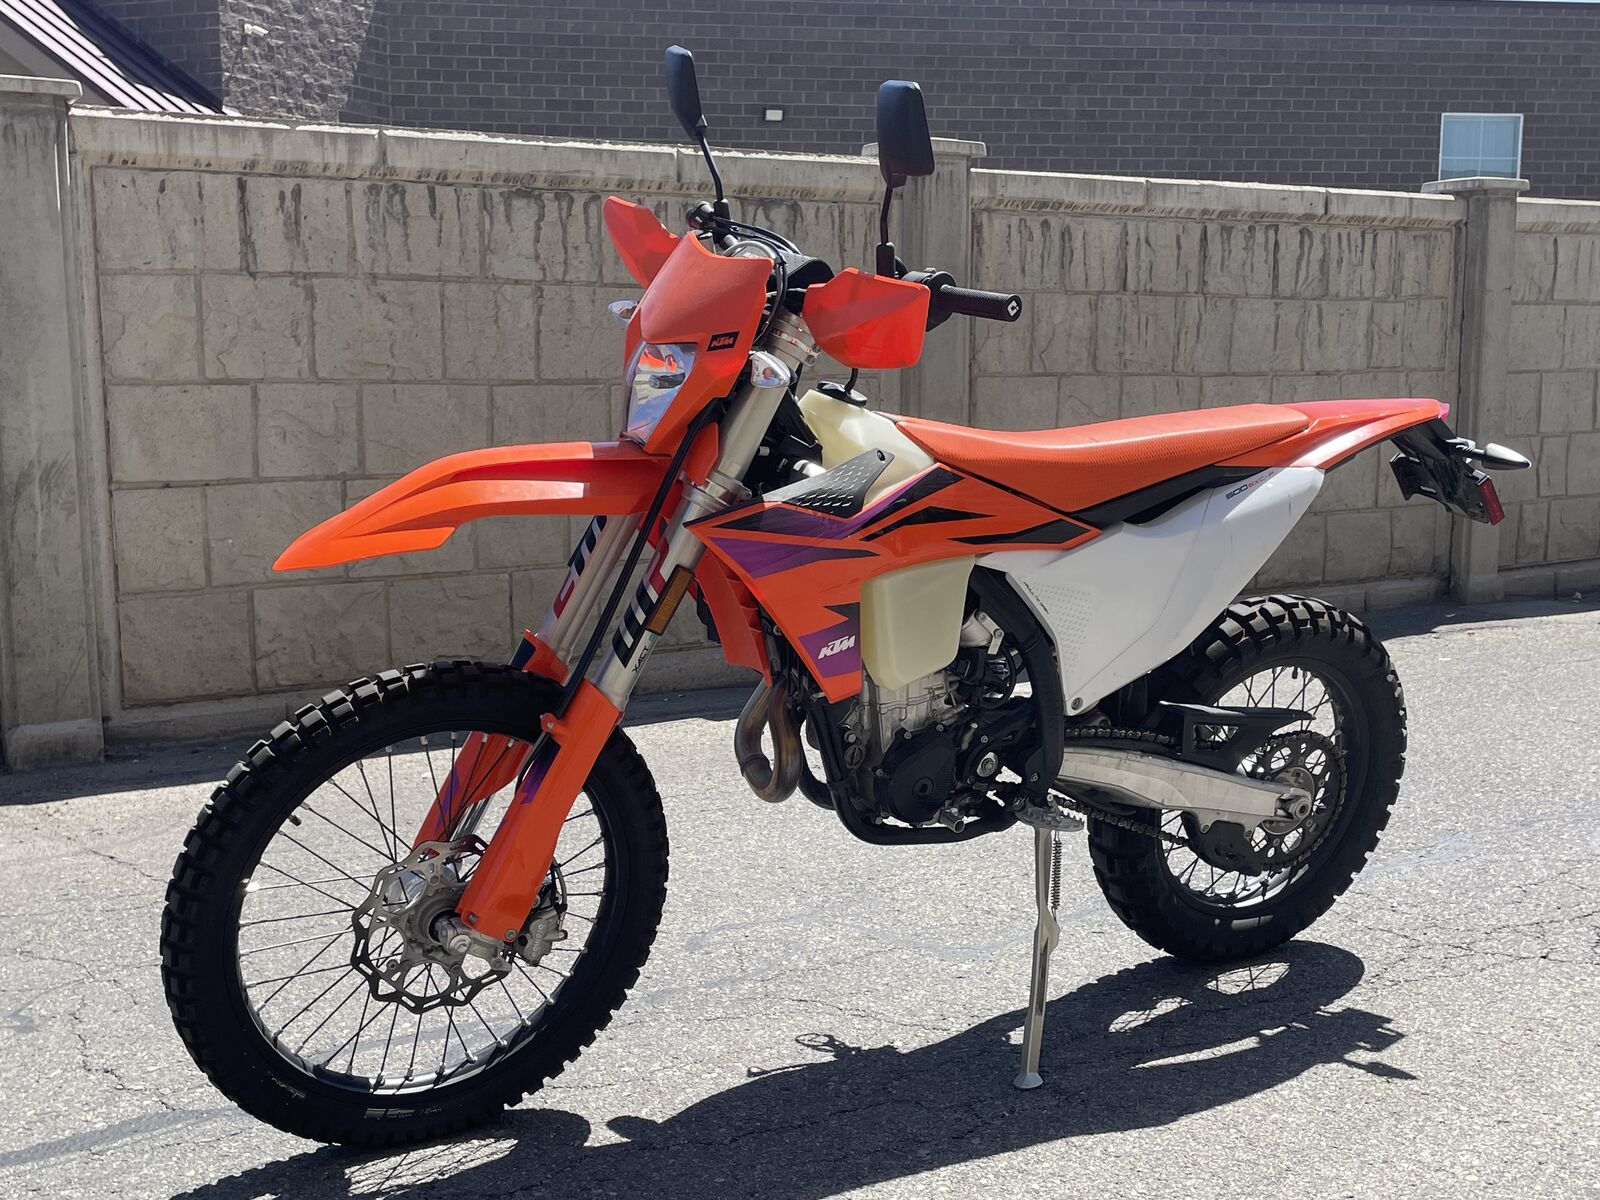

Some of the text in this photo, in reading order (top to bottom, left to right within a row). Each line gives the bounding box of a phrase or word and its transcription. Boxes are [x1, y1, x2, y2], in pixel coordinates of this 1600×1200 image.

[710, 336, 735, 348] KTM
[632, 644, 649, 673] XACT
[817, 635, 856, 660] KTM
